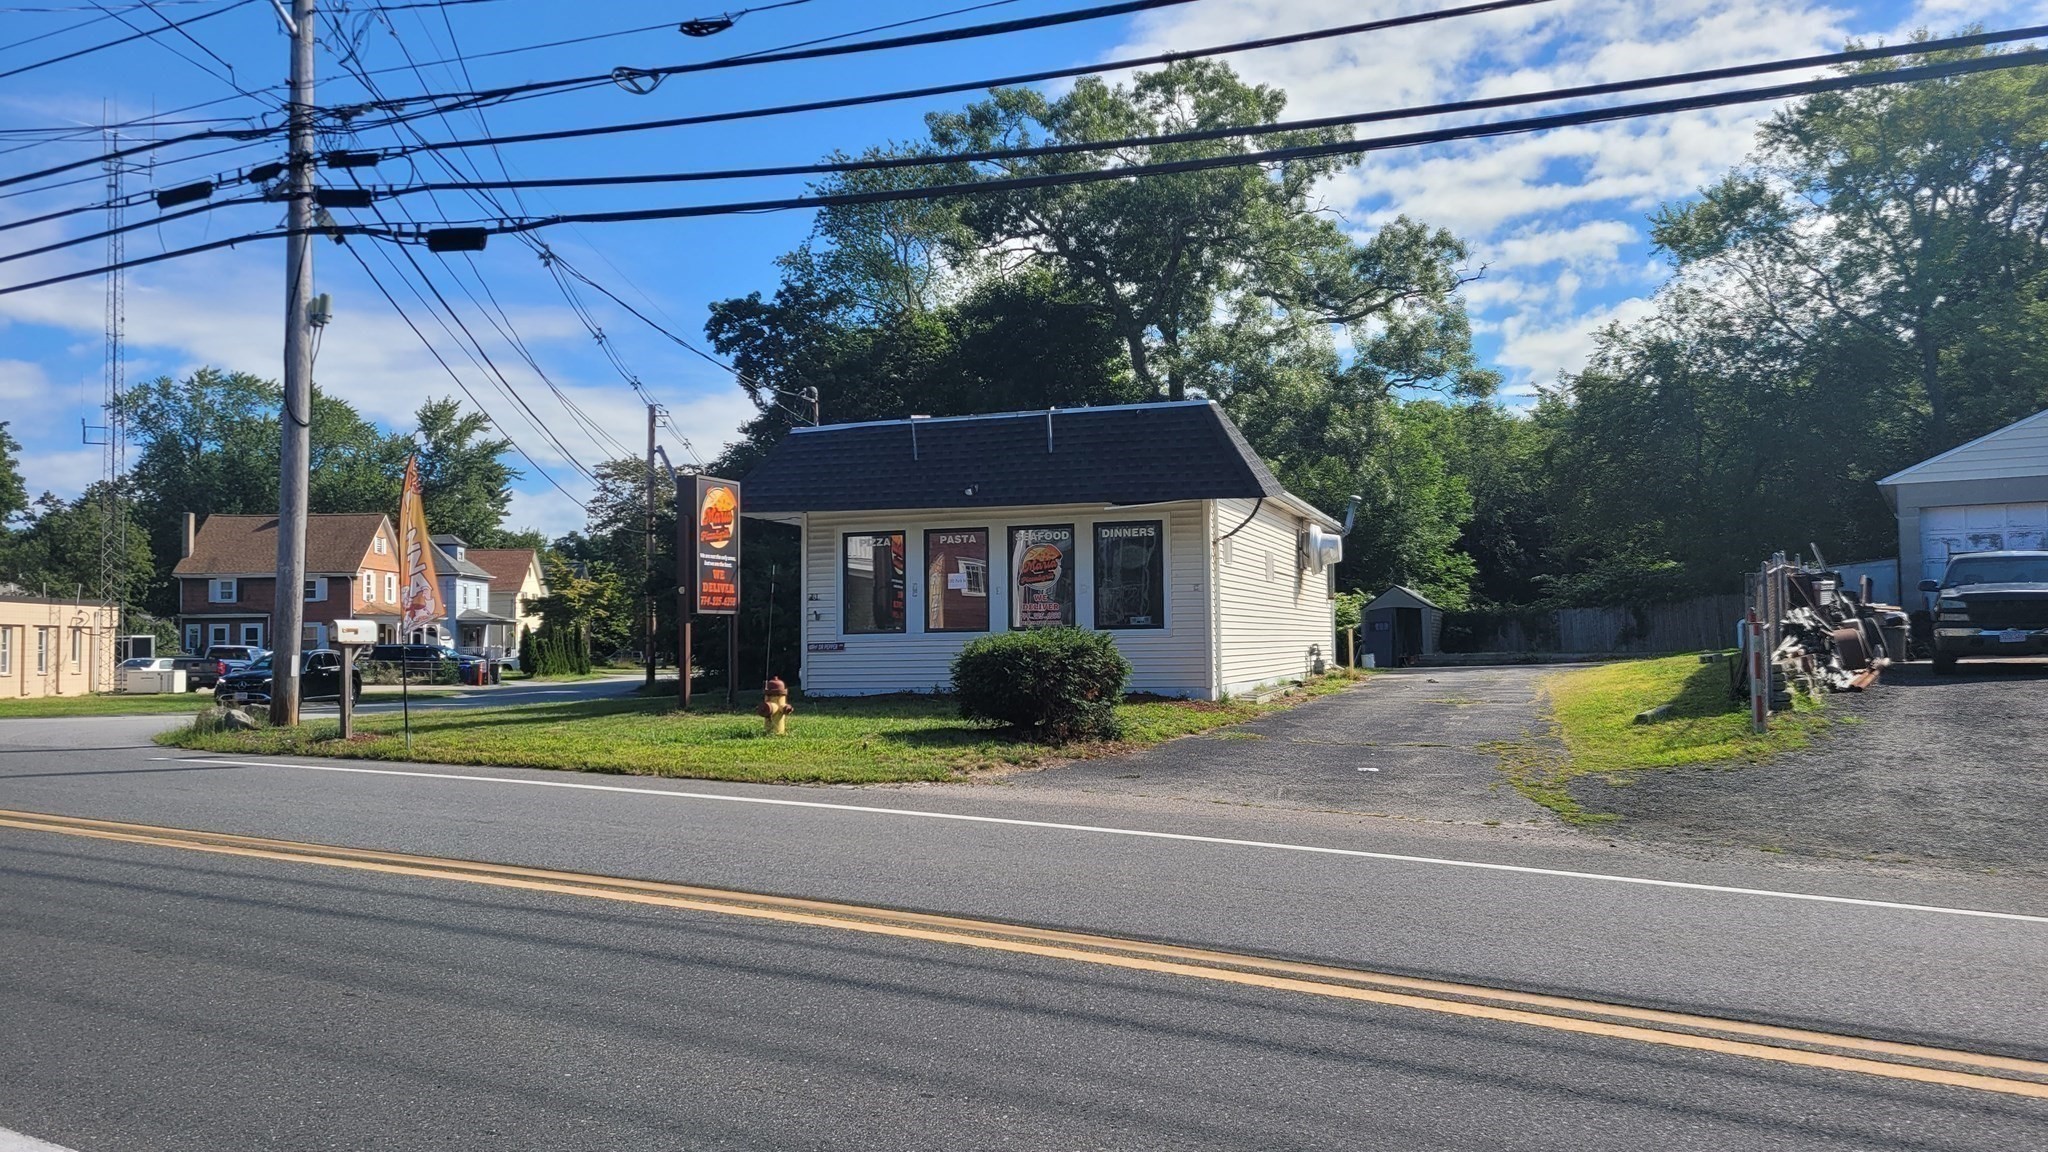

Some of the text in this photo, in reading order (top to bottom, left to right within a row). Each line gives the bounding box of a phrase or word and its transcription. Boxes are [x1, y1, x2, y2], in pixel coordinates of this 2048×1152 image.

[1015, 531, 1069, 541] SEAFOOD
[1102, 527, 1155, 538] DINNERS
[859, 537, 891, 547] PIZZA
[939, 534, 977, 544] PASTA
[712, 569, 726, 580] WE
[702, 582, 735, 594] DELIVER
[1033, 593, 1049, 602] WE
[1022, 602, 1061, 612] DELIVER
